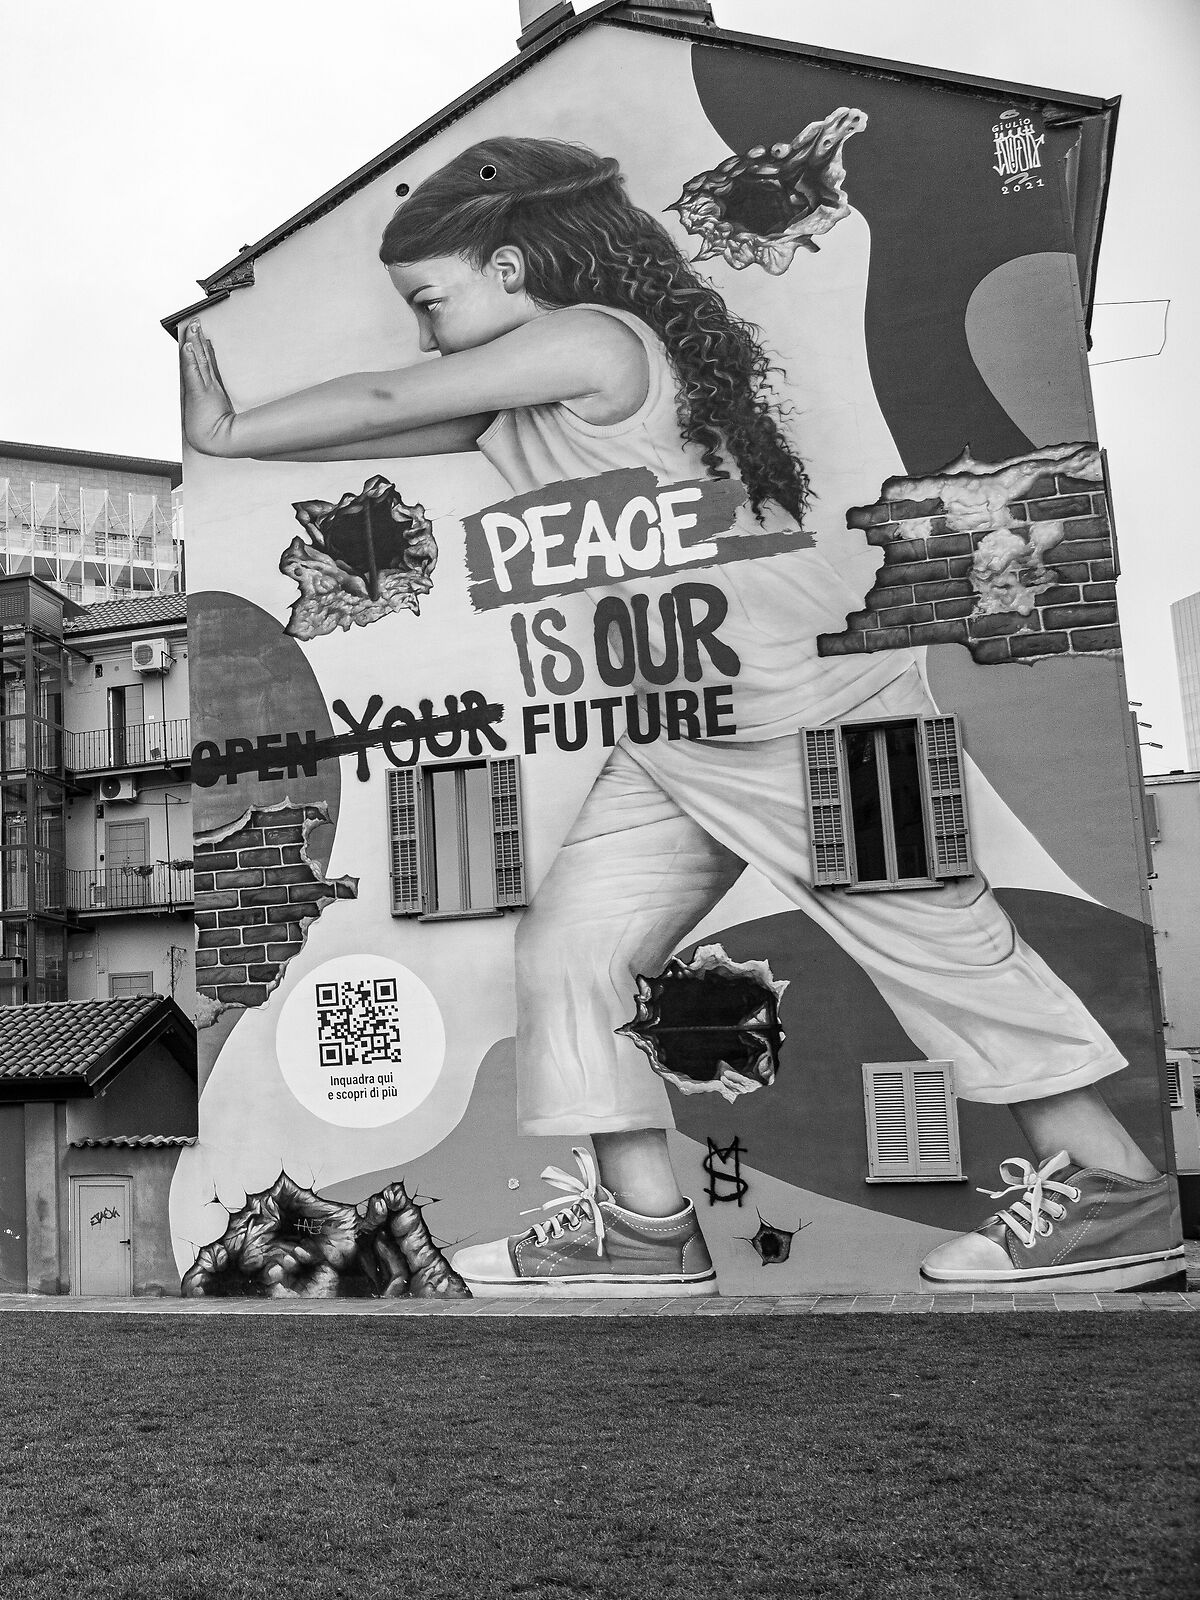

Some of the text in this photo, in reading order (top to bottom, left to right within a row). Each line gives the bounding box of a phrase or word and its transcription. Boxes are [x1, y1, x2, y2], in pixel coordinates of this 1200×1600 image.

[1001, 179, 1045, 195] 2021
[481, 487, 719, 592] PEACE
[511, 582, 741, 698] IS OUR
[191, 685, 737, 787] OPEN YOUR FUTURE
[328, 1086, 398, 1101] e scopri di più
[330, 1072, 393, 1087] Inquadra qui
